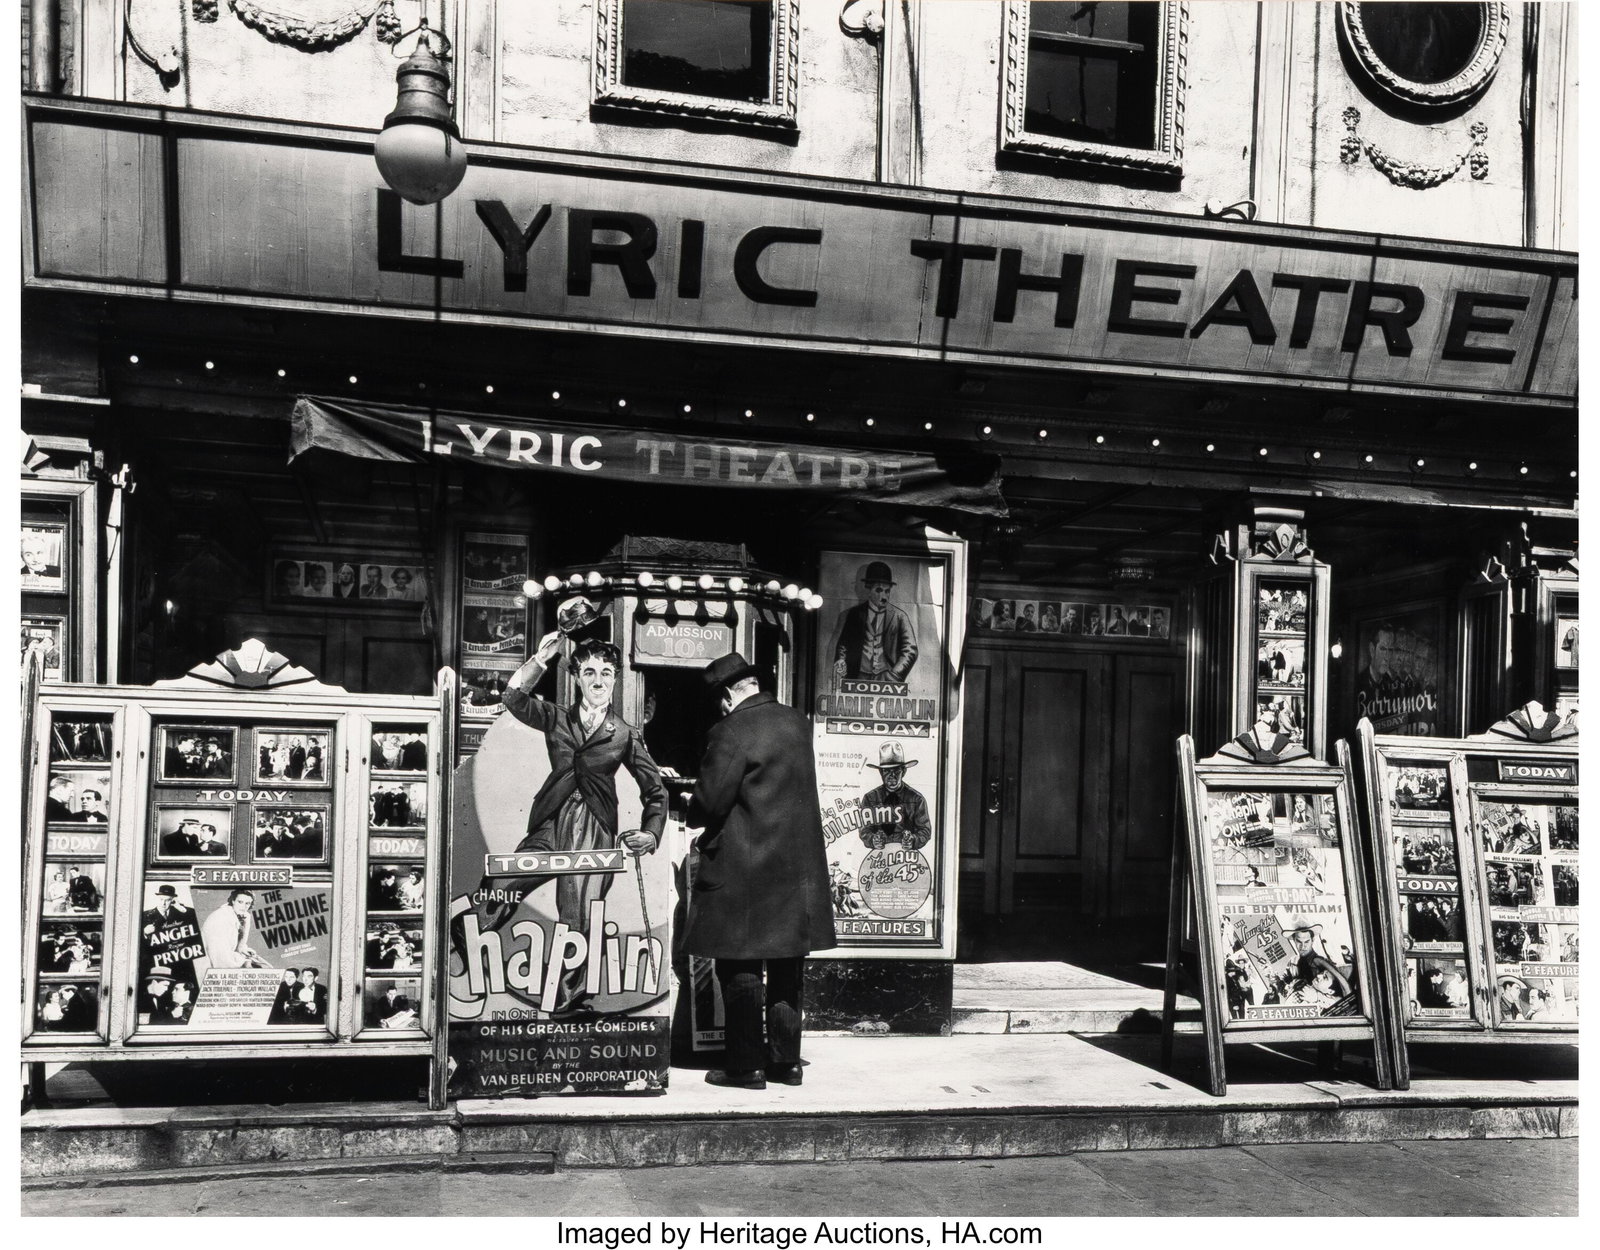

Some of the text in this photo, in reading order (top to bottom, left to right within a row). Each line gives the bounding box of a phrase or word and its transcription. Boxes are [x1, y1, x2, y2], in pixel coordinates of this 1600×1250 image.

[377, 187, 1531, 364] LYRIC THEATRE
[420, 419, 900, 491] LYRIC THEATRE
[646, 626, 723, 641] ADMISSION
[844, 681, 906, 694] TODAY
[816, 694, 936, 721] CHARLIE CHAPLIN
[831, 720, 925, 736] TO-DAY
[1504, 765, 1568, 778] TODAY
[201, 789, 287, 801] TODAY
[834, 797, 863, 812] Boy
[1222, 821, 1247, 838] ONE
[50, 835, 102, 851] TODAY
[373, 838, 420, 854] TODAY
[494, 852, 618, 872] TO-DAY
[887, 849, 919, 867] LAW
[198, 870, 288, 882] 2 FEATURES
[1397, 879, 1459, 892] TODAY
[261, 889, 282, 904] THE
[472, 888, 523, 905] CHARLIE
[1273, 888, 1313, 903] TO-DAY
[251, 893, 329, 930] HEADLINE
[1223, 904, 1342, 914] BIG BOY WILLIAMS
[260, 914, 328, 950] WOMAN
[842, 920, 922, 934] FEATURES
[150, 924, 199, 947] ANGEL
[153, 944, 204, 967] PRYOR
[449, 895, 663, 1020] Chaplin
[1524, 965, 1531, 975] 2
[491, 1007, 539, 1021] IN ONE
[1250, 1008, 1317, 1019] 2 FEATURES
[480, 1026, 497, 1036] OF
[501, 1025, 523, 1036] HIS
[480, 1044, 657, 1063] MUSIC AND SOUND
[552, 1062, 562, 1070] BY
[480, 1069, 658, 1087] VAN BEUREN CORPORATION
